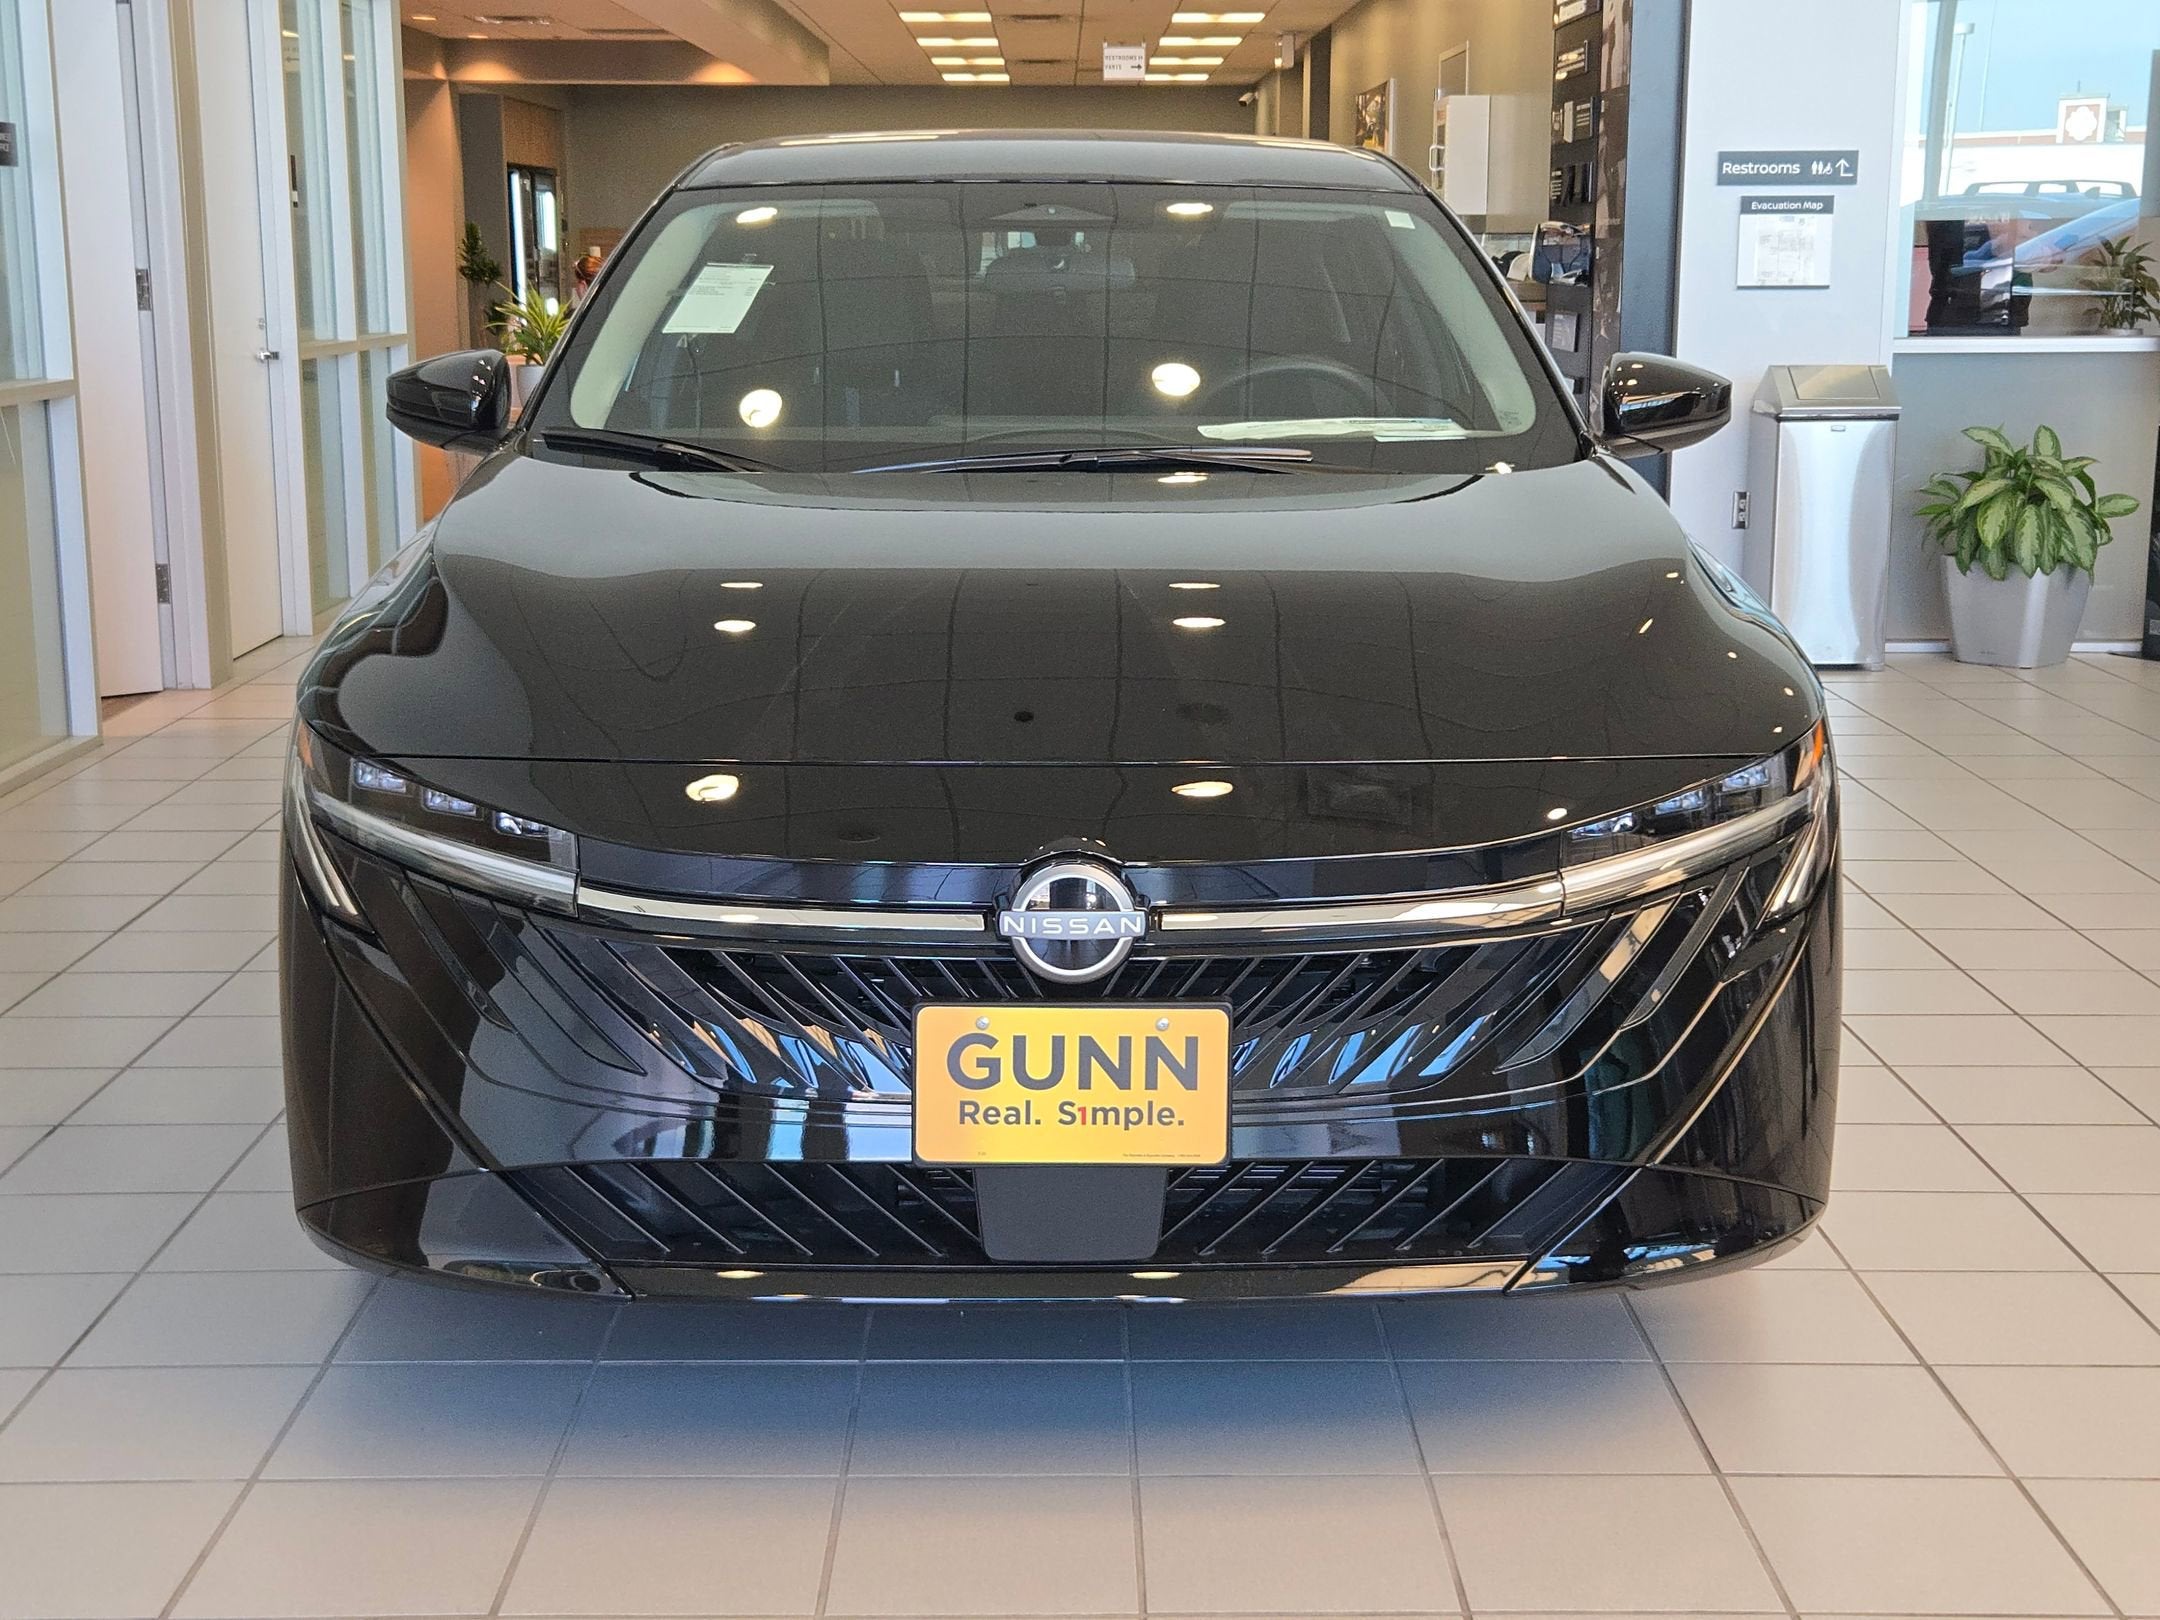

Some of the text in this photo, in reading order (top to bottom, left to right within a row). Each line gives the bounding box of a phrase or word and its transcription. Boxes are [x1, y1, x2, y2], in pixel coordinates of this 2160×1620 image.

[1722, 162, 1801, 175] Restrooms
[1751, 201, 1824, 211] Evacuation Map
[1003, 915, 1142, 935] NISSAN
[946, 1032, 1199, 1091] GUNN
[959, 1099, 1185, 1131] Real. S1mple.
